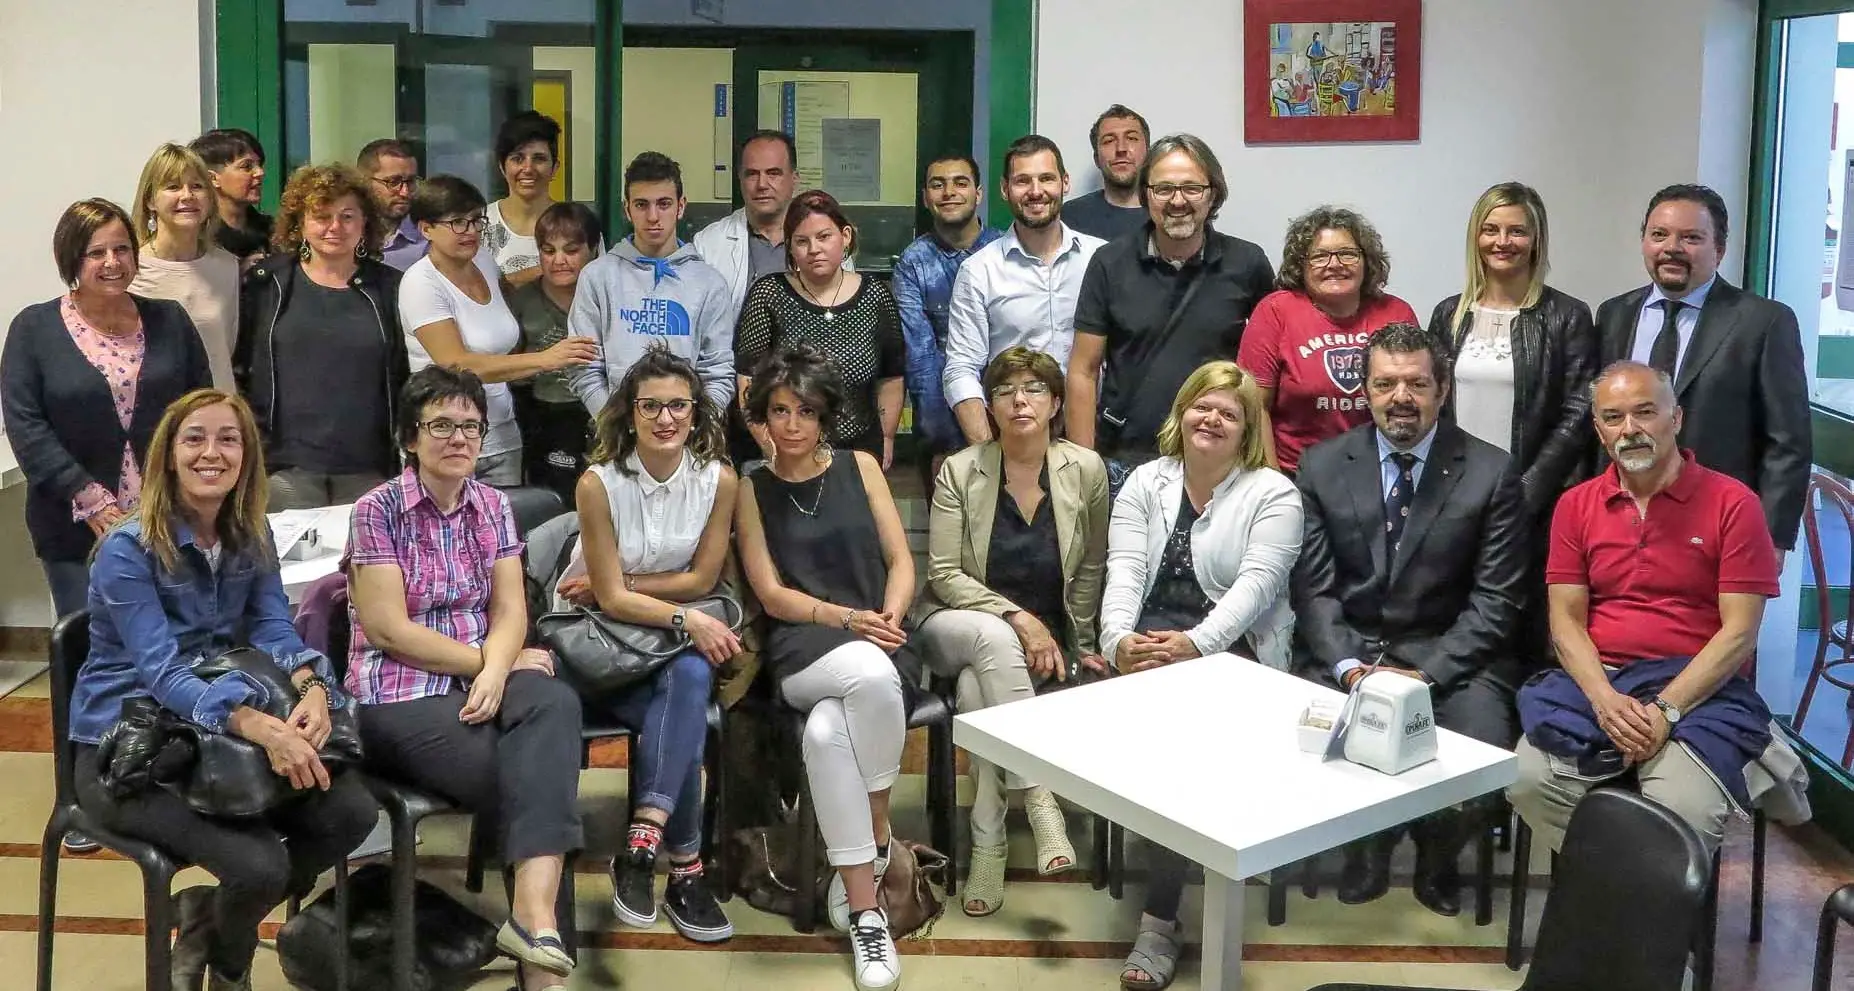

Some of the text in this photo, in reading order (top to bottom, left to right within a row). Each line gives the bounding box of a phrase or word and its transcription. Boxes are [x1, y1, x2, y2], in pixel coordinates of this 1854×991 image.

[641, 298, 666, 311] THE
[620, 309, 666, 322] NORTH
[632, 322, 666, 335] FACE
[1298, 332, 1370, 359] AMERIC
